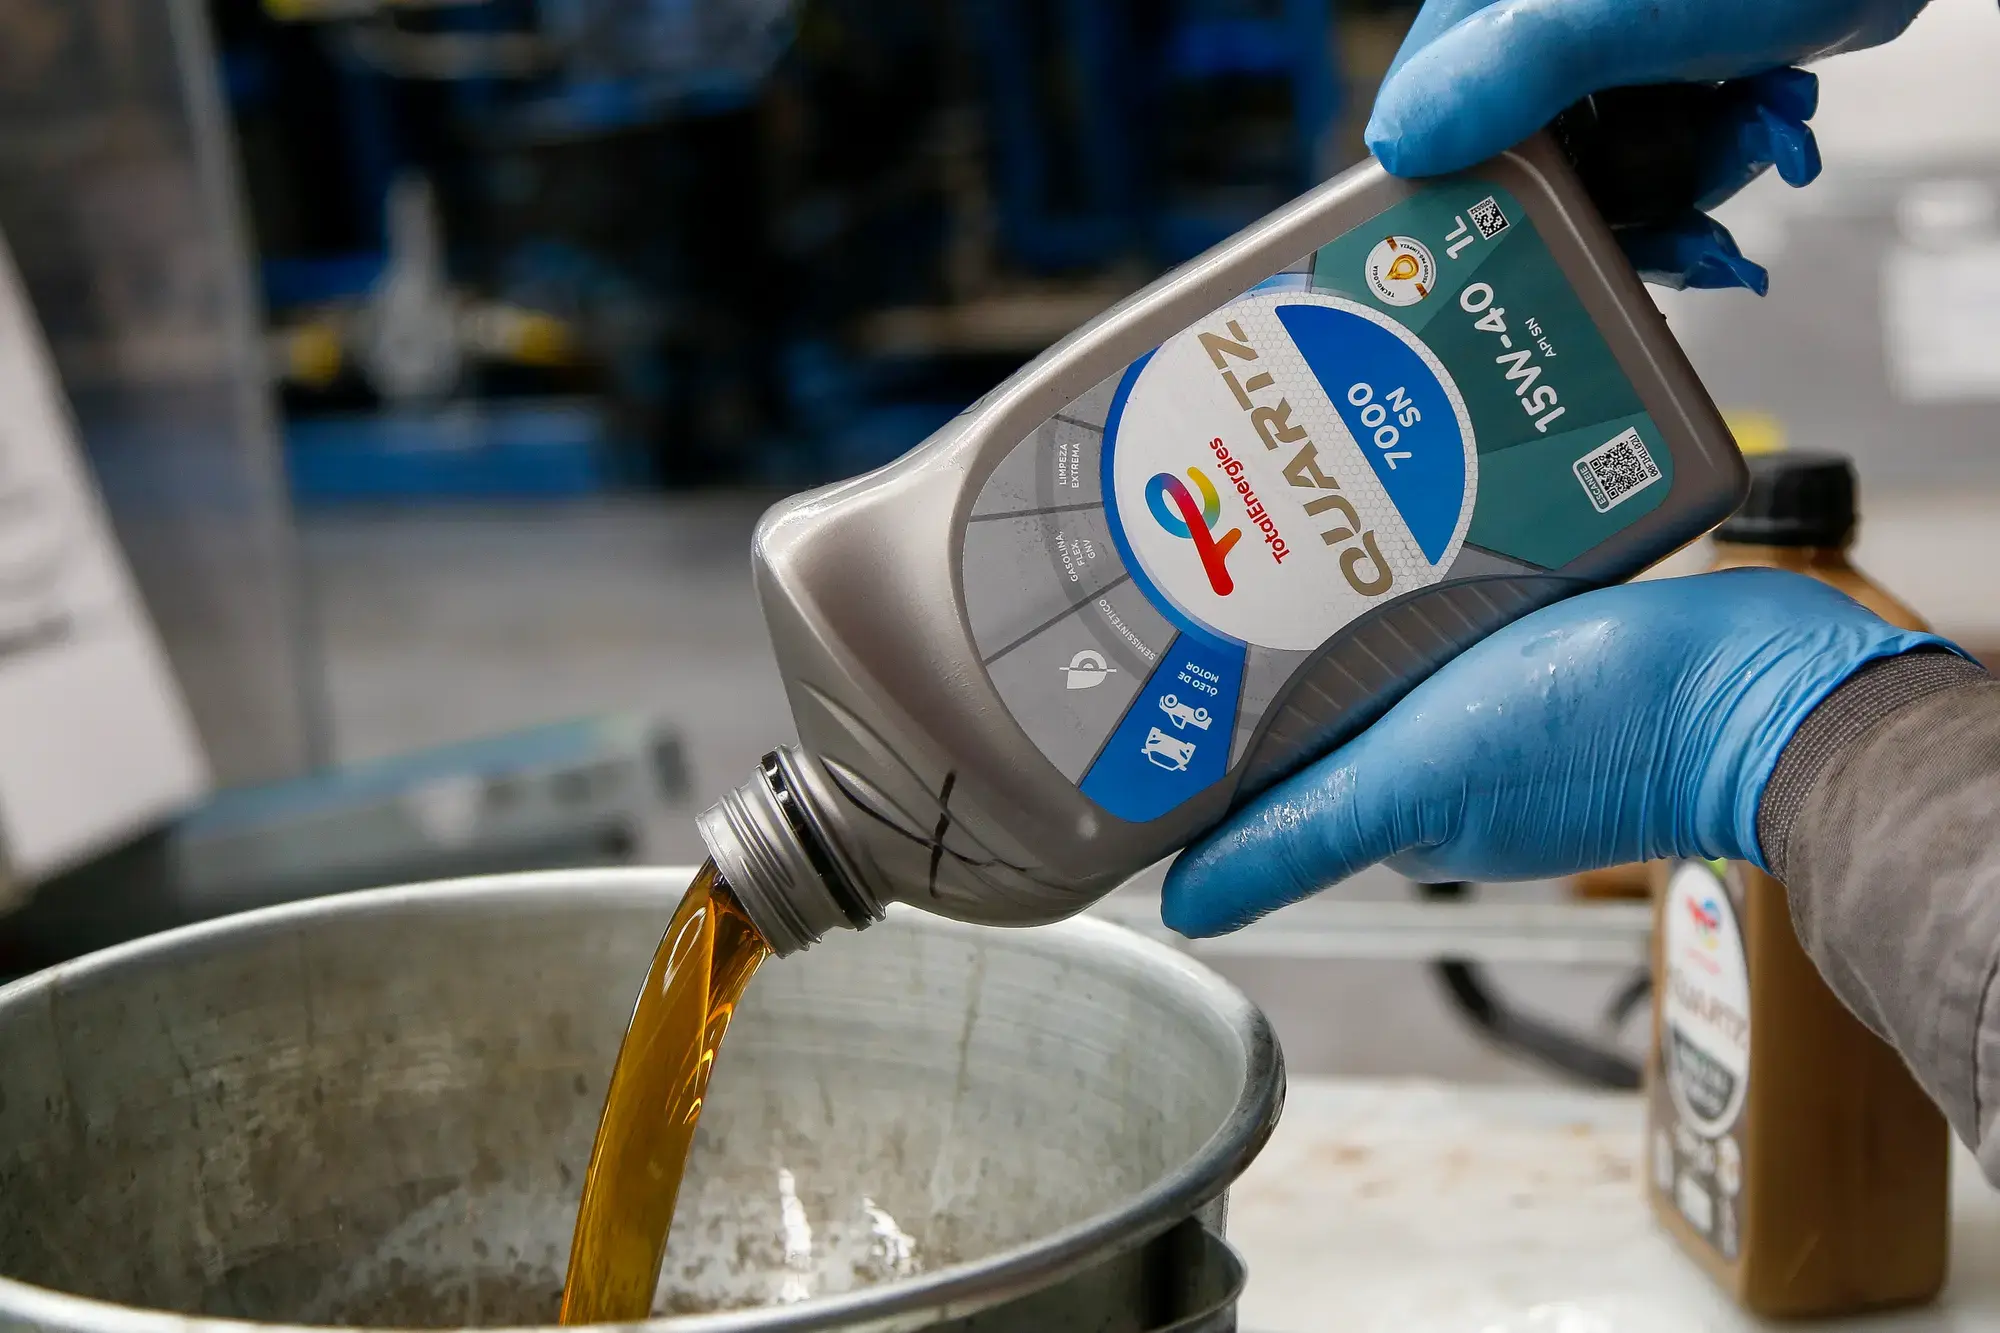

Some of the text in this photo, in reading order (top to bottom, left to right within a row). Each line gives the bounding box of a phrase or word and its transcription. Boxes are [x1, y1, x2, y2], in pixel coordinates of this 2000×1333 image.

[1445, 216, 1474, 259] 1L
[1372, 265, 1396, 297] TECNOLOGIA
[1460, 282, 1565, 433] 15W-40
[1525, 317, 1557, 358] API SN
[1348, 382, 1412, 470] 7000
[1386, 386, 1421, 427] SN
[1059, 443, 1068, 485] LIMPEZA
[1072, 442, 1080, 488] EXTREMA
[1198, 320, 1394, 596] QUARTZ
[1209, 436, 1290, 564] TotalEnergies
[1579, 464, 1607, 506] ESCANEIE
[1054, 530, 1080, 583] GASOLINA,
[1070, 539, 1086, 567] FLEX,
[1082, 538, 1097, 560] GNV
[1098, 598, 1157, 661] SEMISSINTÉTICO
[1176, 670, 1218, 697] ÓLEO DE
[1184, 660, 1220, 683] MOTOR
